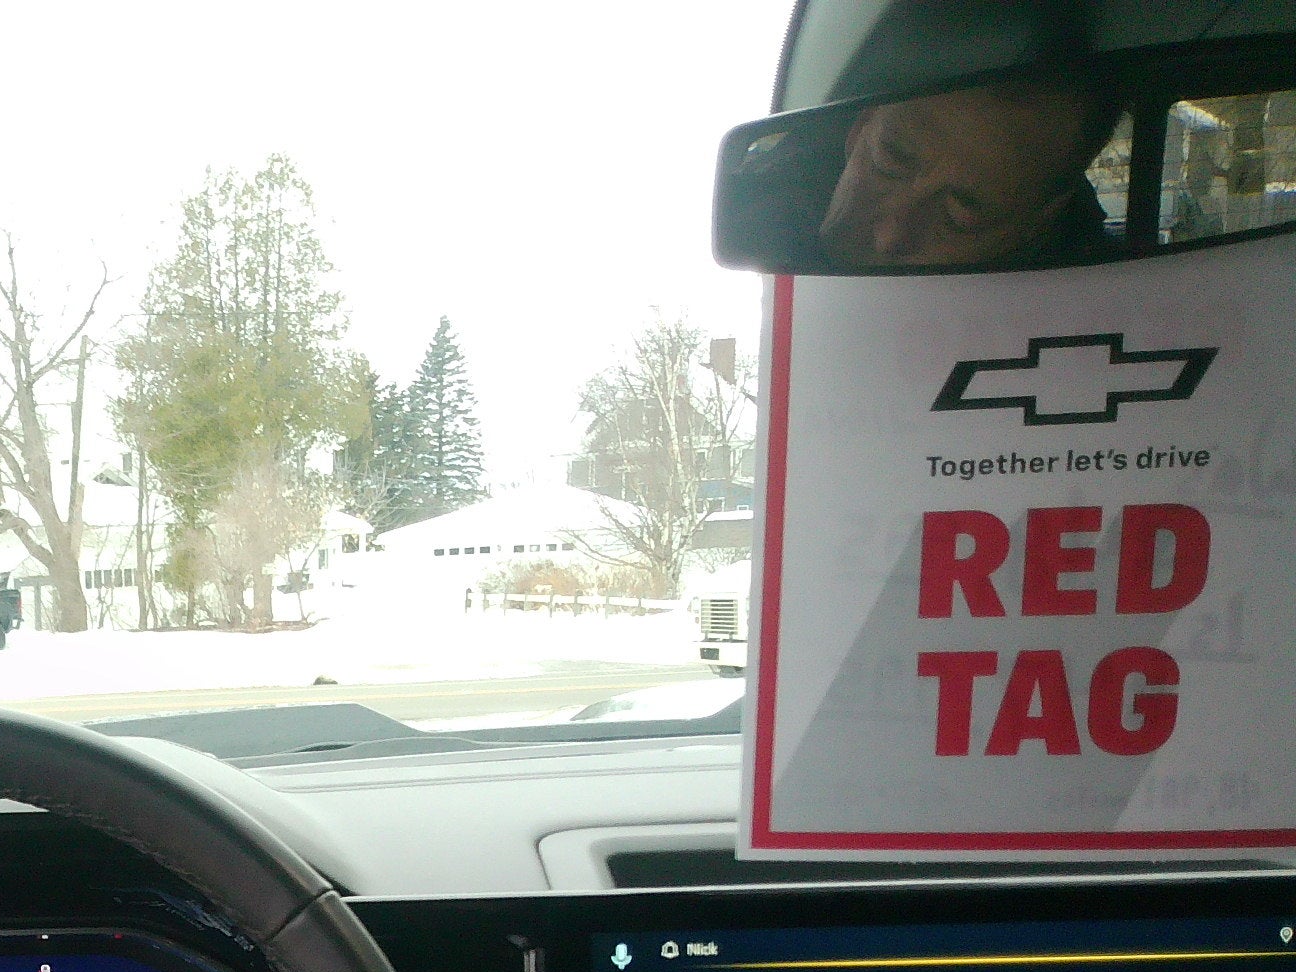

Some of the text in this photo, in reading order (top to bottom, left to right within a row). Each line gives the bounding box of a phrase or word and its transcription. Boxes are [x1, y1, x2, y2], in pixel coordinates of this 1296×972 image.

[926, 444, 1211, 480] Together let's drive
[917, 503, 1212, 619] RED
[917, 646, 1181, 757] TAG
